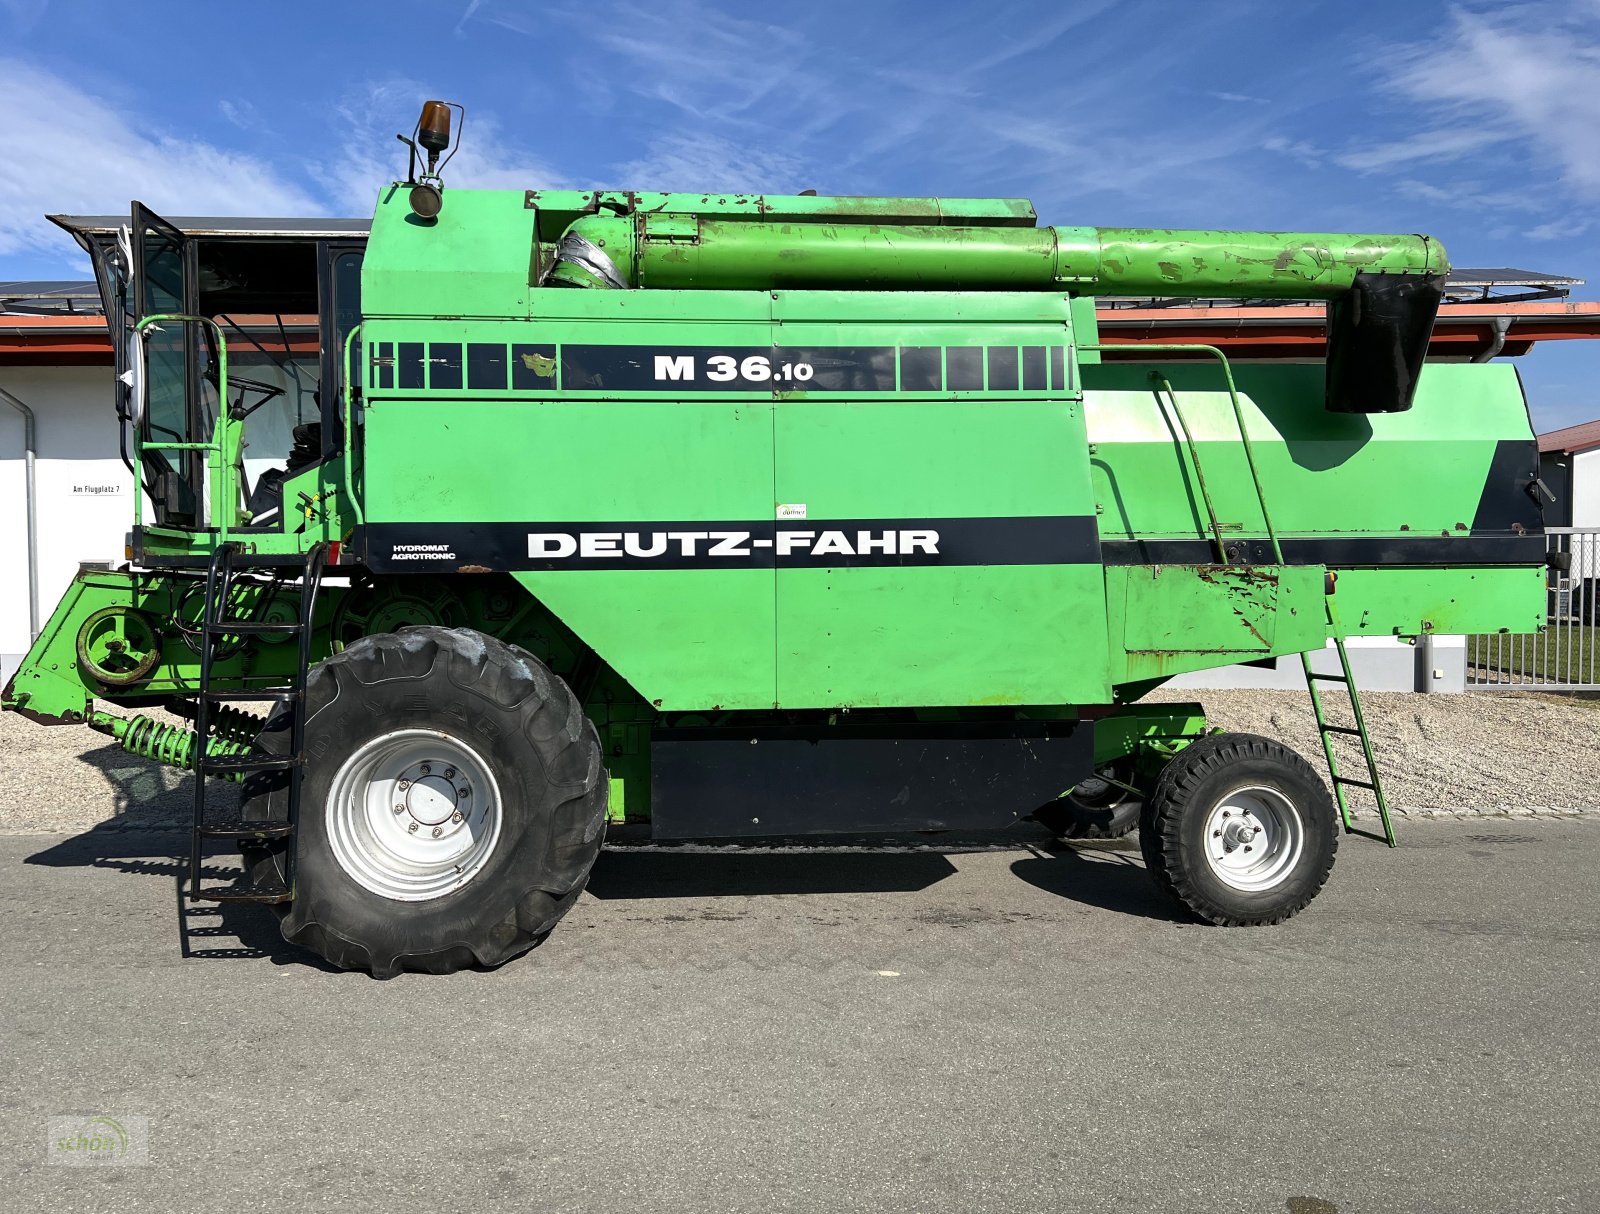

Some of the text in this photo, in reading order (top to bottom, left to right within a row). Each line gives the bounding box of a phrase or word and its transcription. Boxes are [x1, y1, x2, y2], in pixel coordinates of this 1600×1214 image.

[654, 355, 814, 382] M 36.10
[73, 485, 120, 495] Am Flugplatz 7
[392, 544, 450, 552] HYDROMAT
[527, 529, 940, 559] DEUTZ-FAHR
[391, 553, 457, 562] AGROTRONIC
